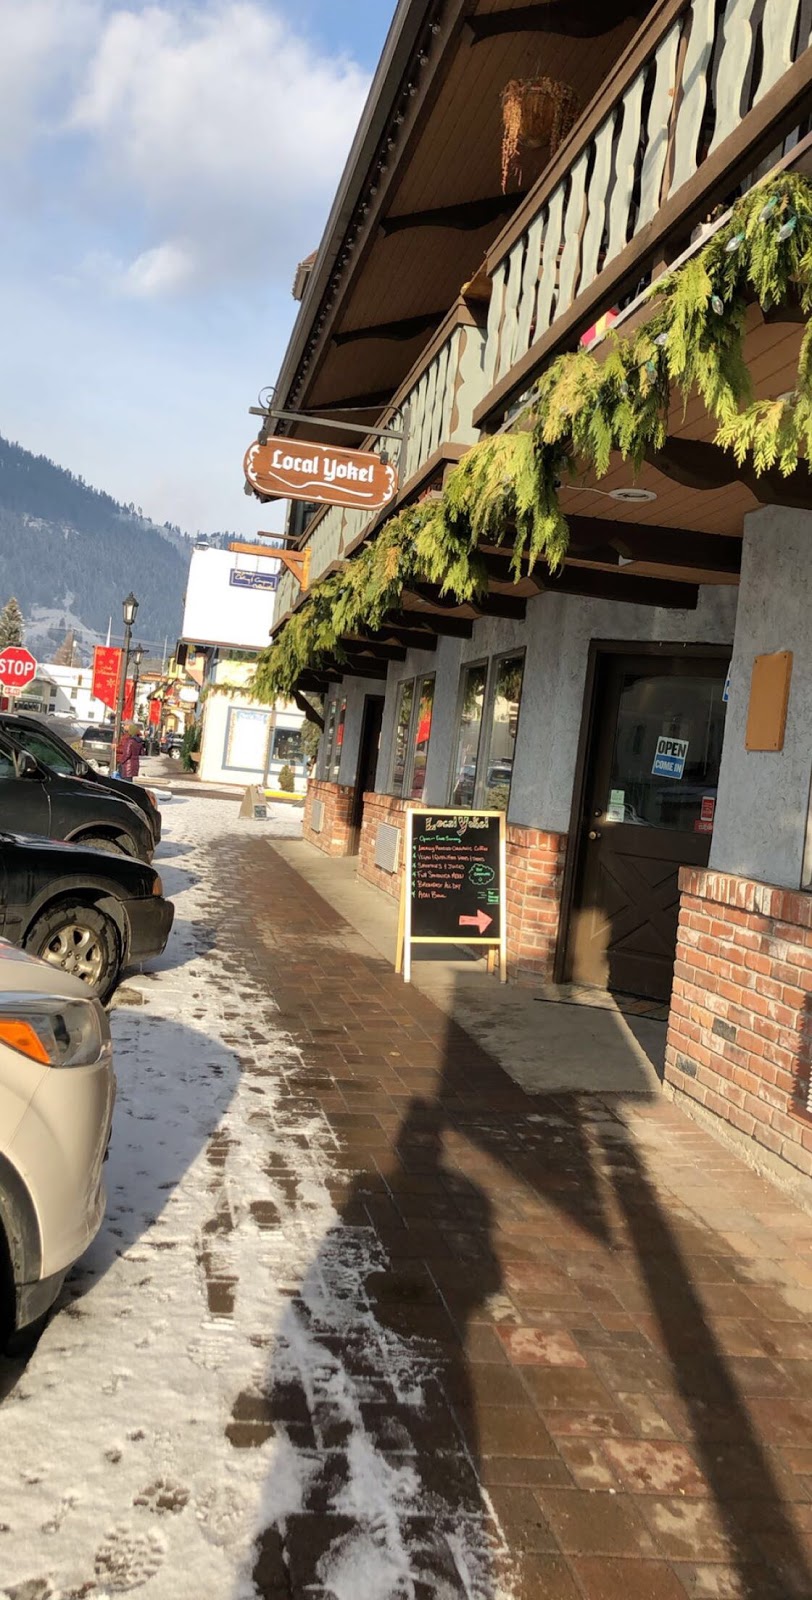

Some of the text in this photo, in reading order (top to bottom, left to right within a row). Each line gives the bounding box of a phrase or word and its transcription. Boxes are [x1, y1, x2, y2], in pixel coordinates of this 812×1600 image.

[271, 449, 374, 483] Local Yokel
[0, 658, 34, 676] STOP
[658, 740, 687, 758] OPEN
[655, 760, 682, 773] COME IN
[425, 816, 489, 836] Local Yokel
